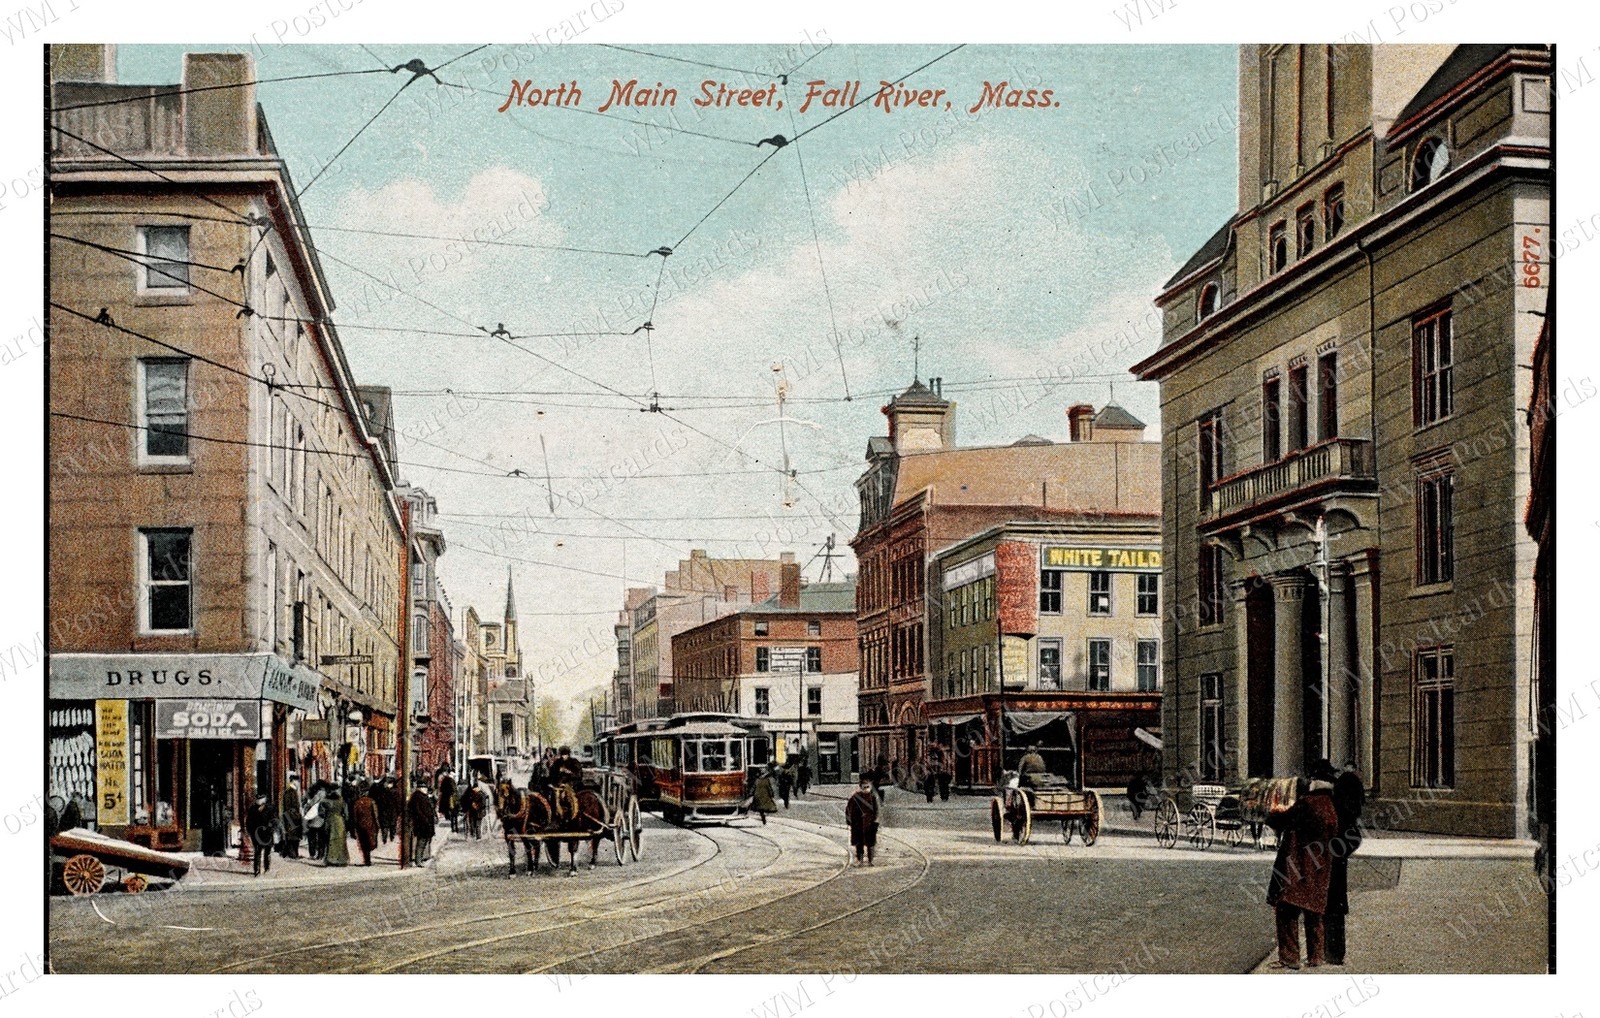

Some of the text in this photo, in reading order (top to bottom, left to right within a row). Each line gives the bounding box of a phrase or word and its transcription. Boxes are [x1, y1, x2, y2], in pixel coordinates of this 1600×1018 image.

[1049, 549, 1102, 566] WHITE
[106, 669, 222, 686] DRUGS.
[173, 711, 248, 727] SODA
